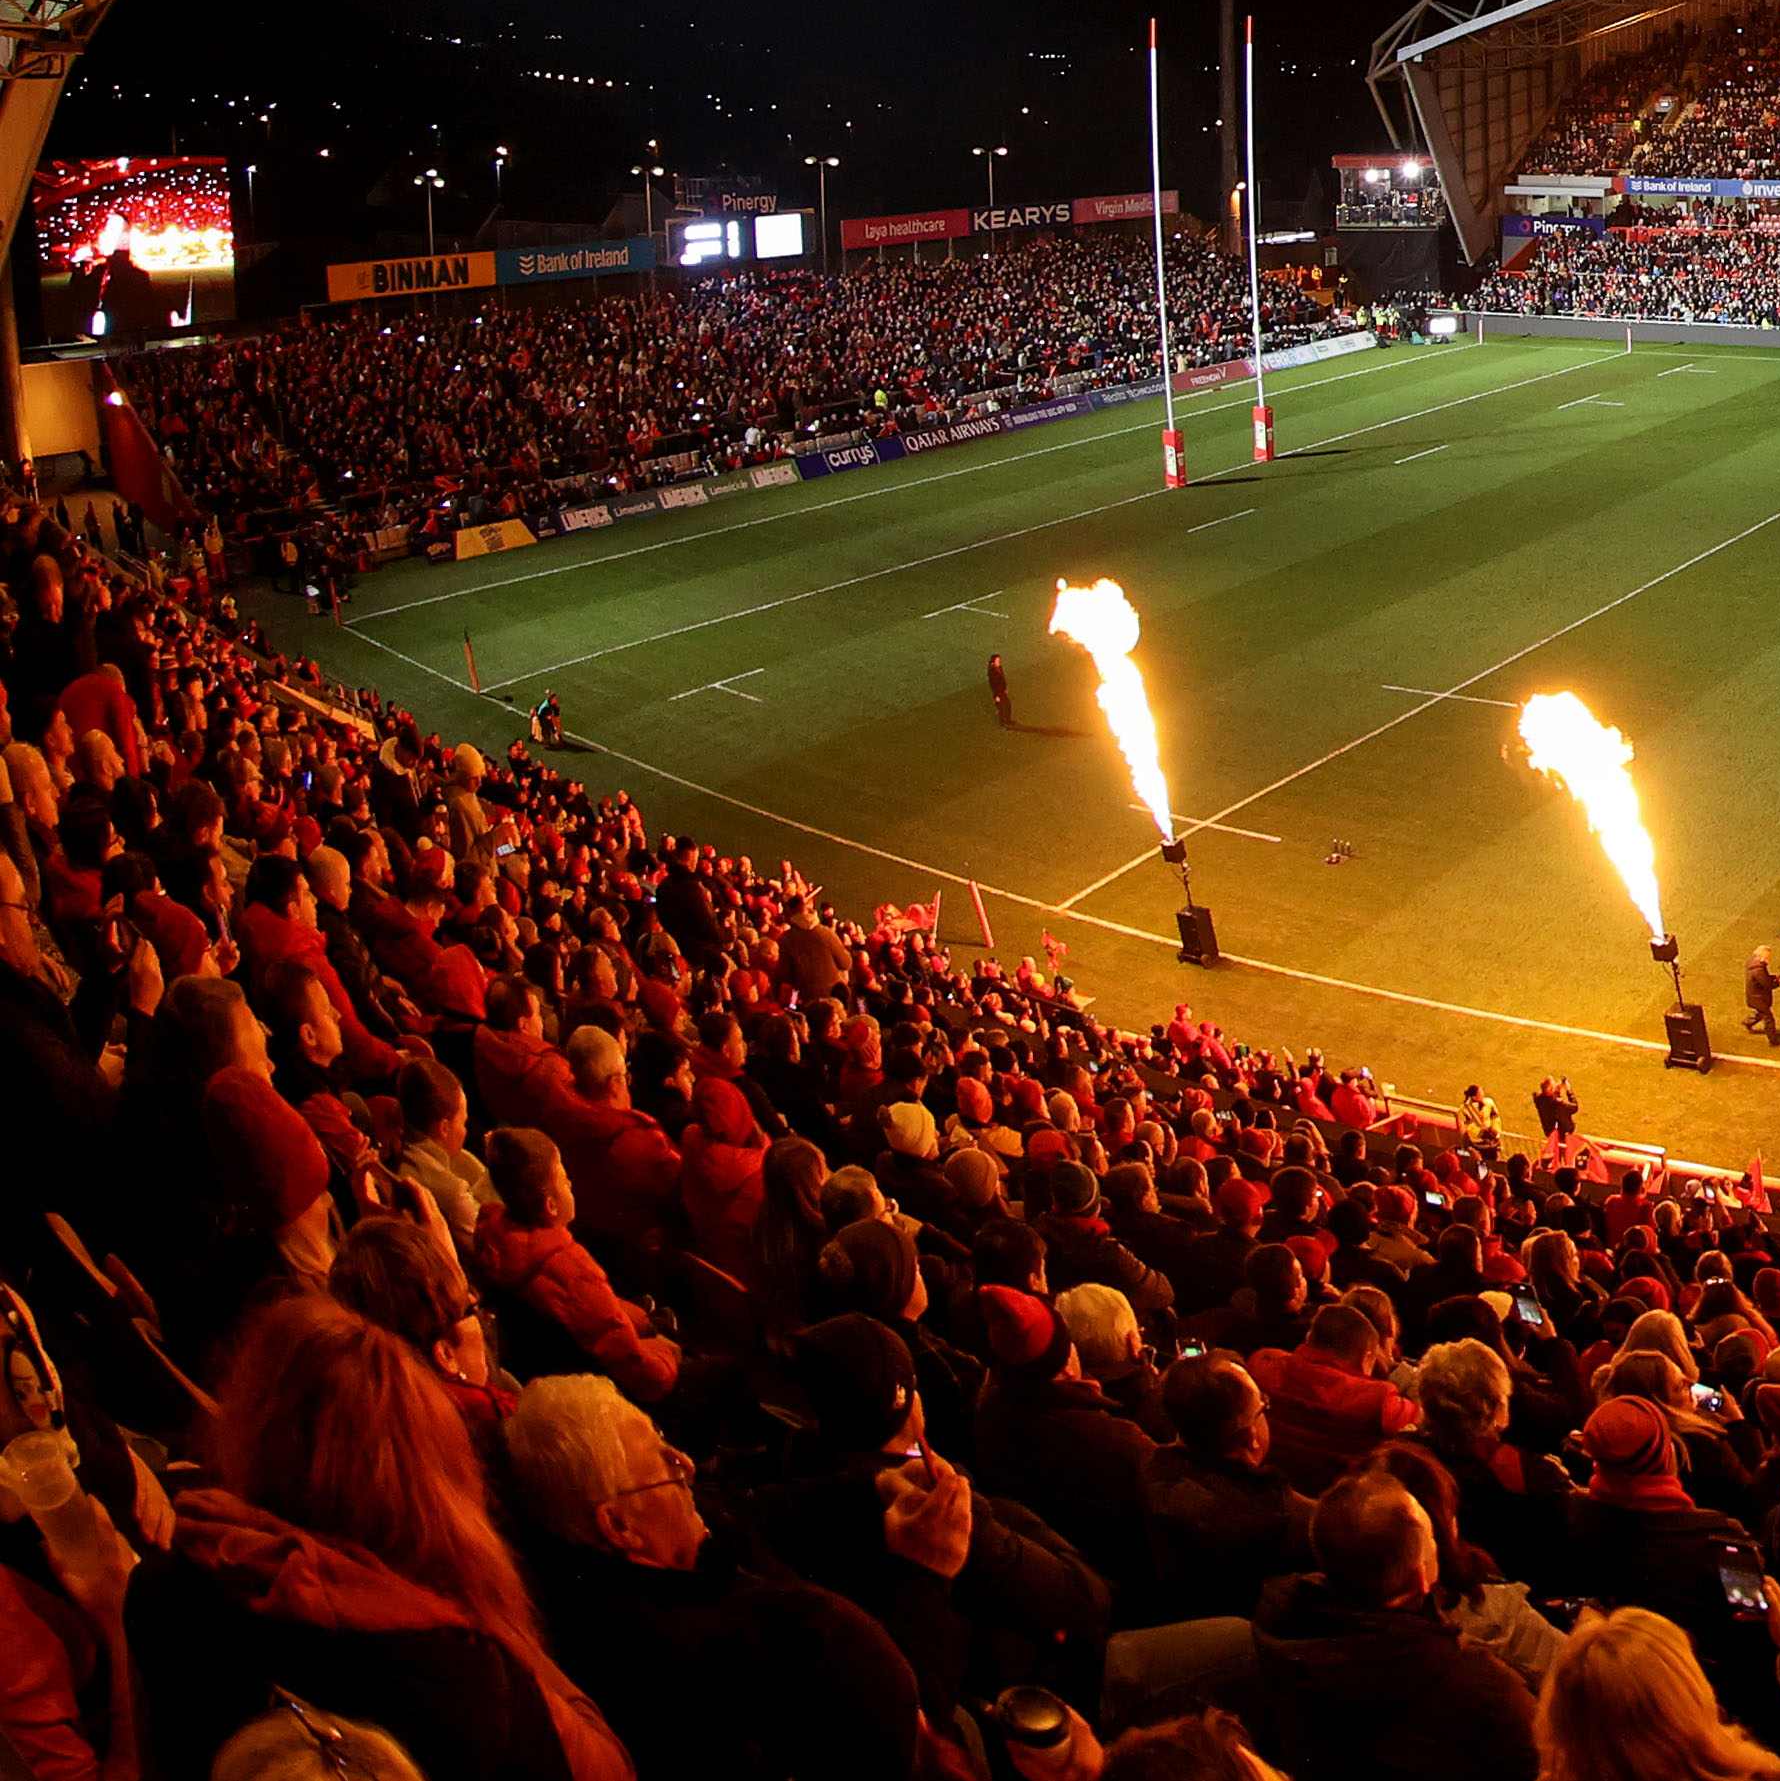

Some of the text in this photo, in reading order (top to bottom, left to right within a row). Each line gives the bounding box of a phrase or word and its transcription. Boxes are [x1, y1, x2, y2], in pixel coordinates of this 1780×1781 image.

[1644, 181, 1712, 193] Bank of Ireland
[722, 192, 777, 213] Pinergy
[1095, 200, 1124, 218] Virgin
[865, 218, 946, 240] laya healthcare
[973, 203, 1071, 232] KEARYS
[537, 246, 630, 275] Bank of Ireland
[374, 257, 469, 294] BINMAN
[905, 430, 950, 452] QATAR
[950, 417, 1001, 442] AIRWAYS
[828, 444, 876, 469] currys
